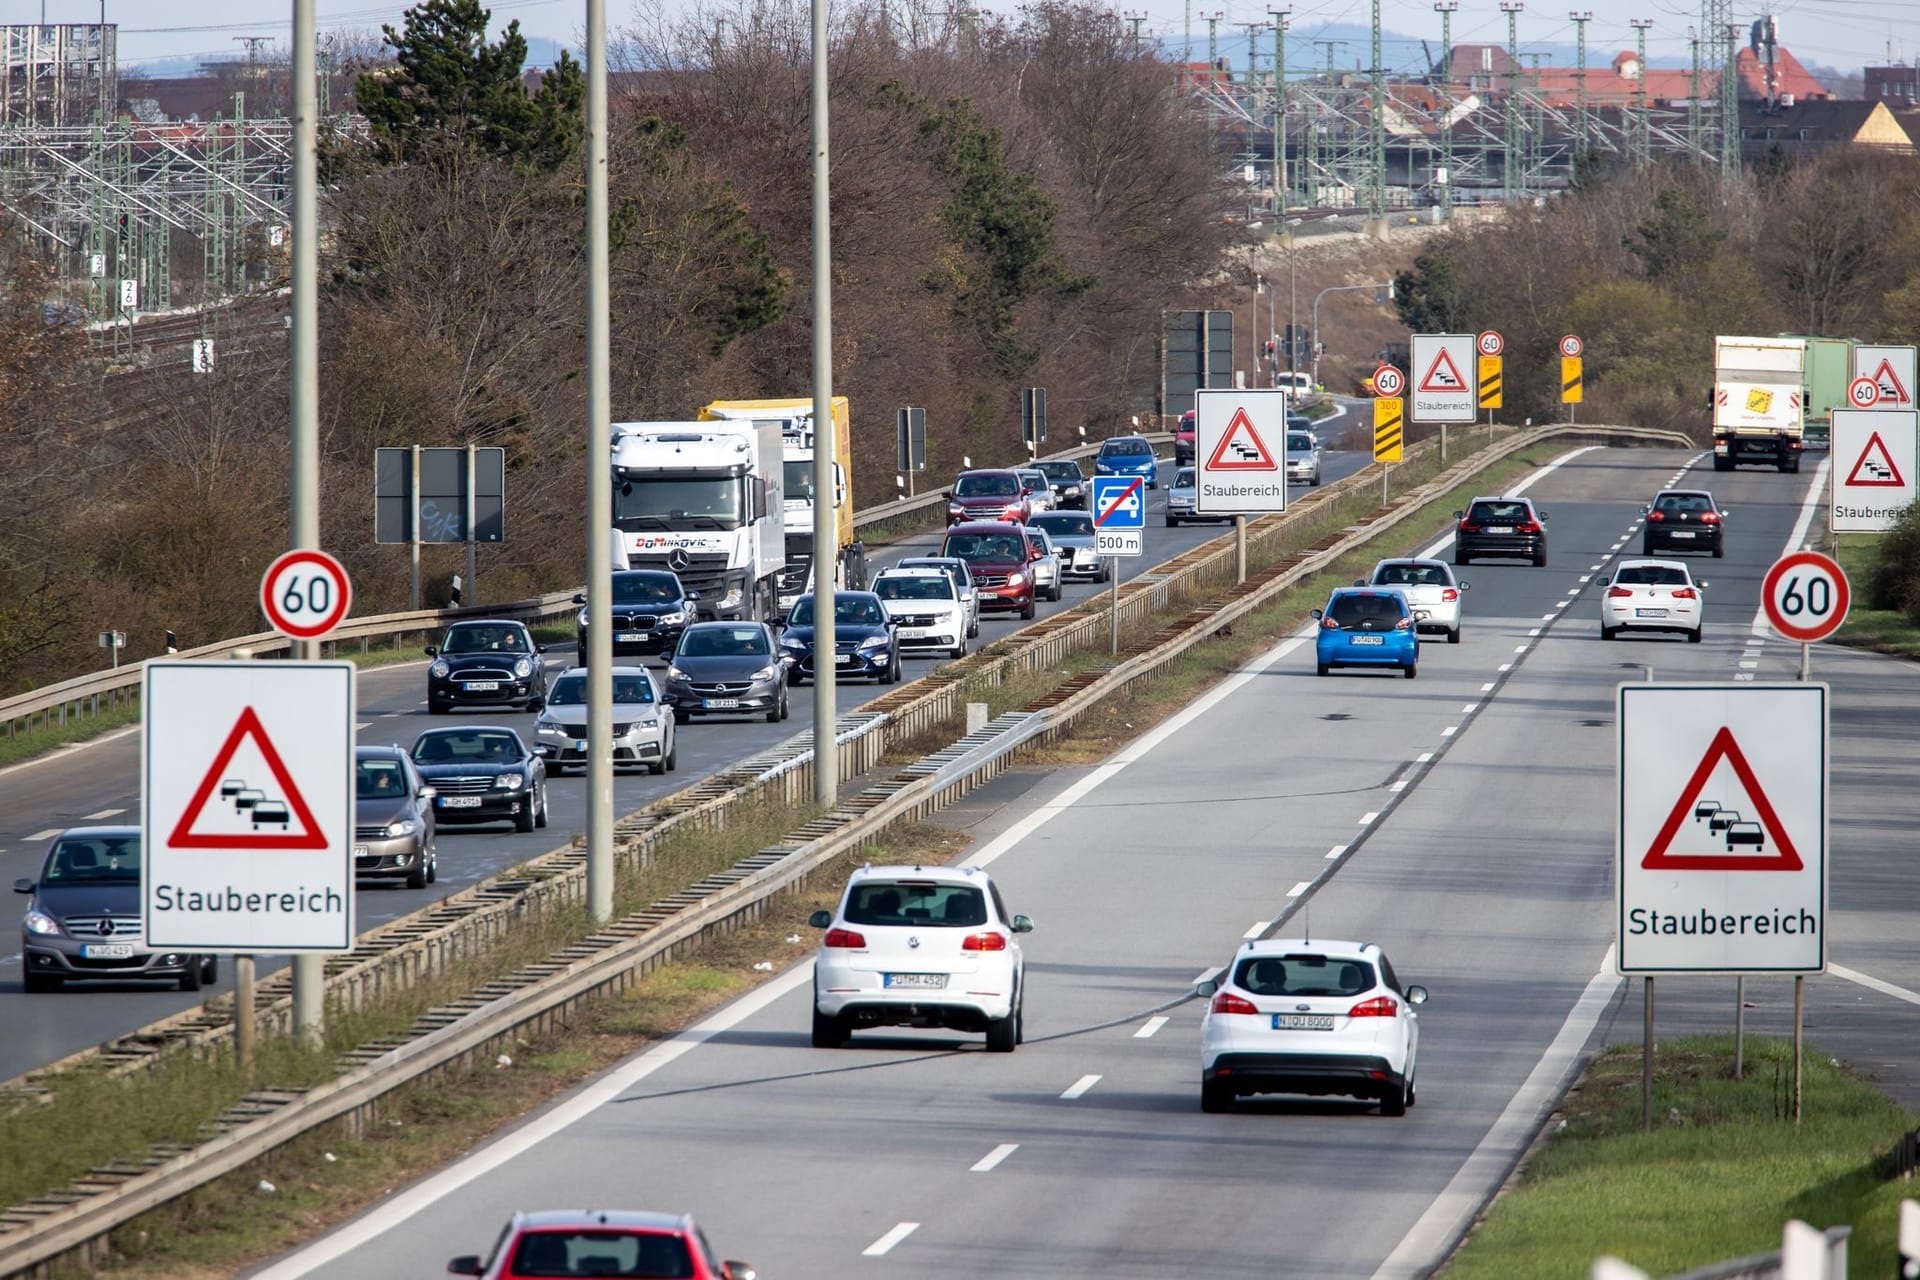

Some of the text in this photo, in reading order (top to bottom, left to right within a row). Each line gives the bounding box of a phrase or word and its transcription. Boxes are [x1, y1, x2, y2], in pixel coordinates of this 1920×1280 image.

[126, 281, 133, 292] 2
[126, 293, 133, 304] 6
[1483, 338, 1498, 350] 60
[1565, 341, 1578, 352] 60
[1380, 374, 1397, 389] 60
[1856, 386, 1873, 400] 60
[1380, 401, 1397, 410] 300
[1417, 401, 1471, 410] Staubereich
[1203, 484, 1280, 497] Staubereich
[1099, 537, 1138, 549] 500 m
[283, 576, 329, 614] 60
[1781, 576, 1830, 616] 60
[155, 885, 342, 913] Staubereich
[1629, 908, 1816, 935] Staubereich
[923, 975, 940, 985] 452
[1279, 1016, 1286, 1025] N
[1307, 1017, 1332, 1027] 8000
